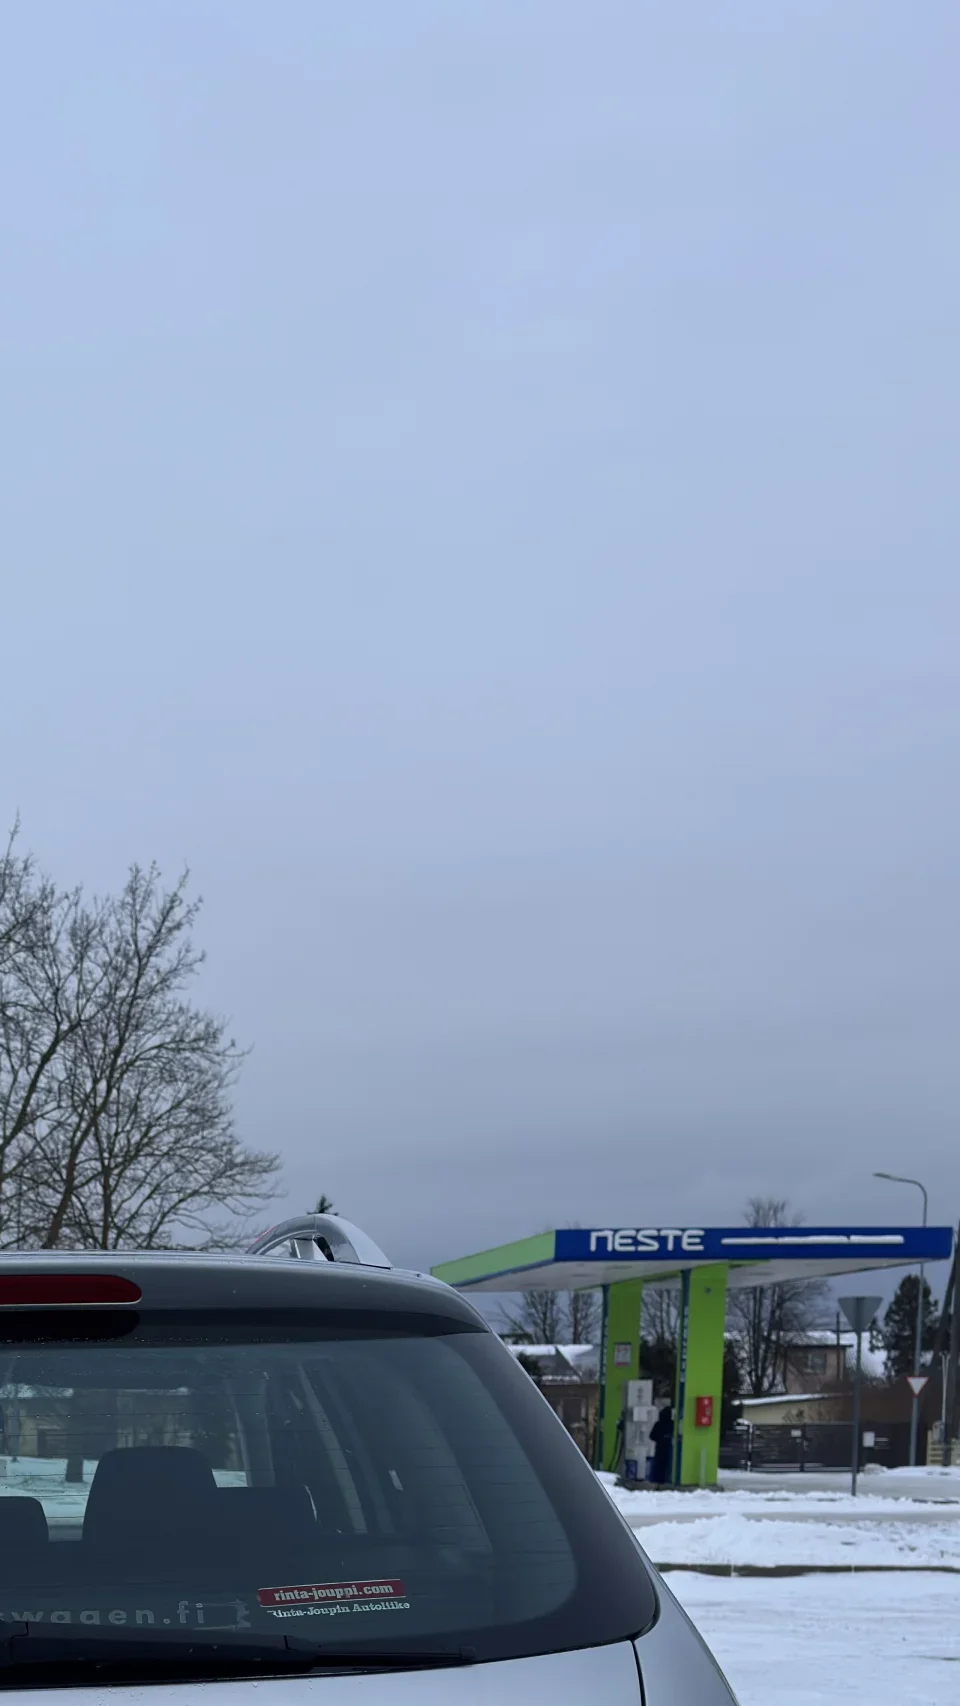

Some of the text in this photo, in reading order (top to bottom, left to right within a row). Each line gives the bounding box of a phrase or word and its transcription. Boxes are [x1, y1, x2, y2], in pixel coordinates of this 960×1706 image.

[590, 1228, 705, 1252] NESTE
[273, 1584, 395, 1601] rinta-jouppi.com
[352, 1600, 411, 1612] Autoliike
